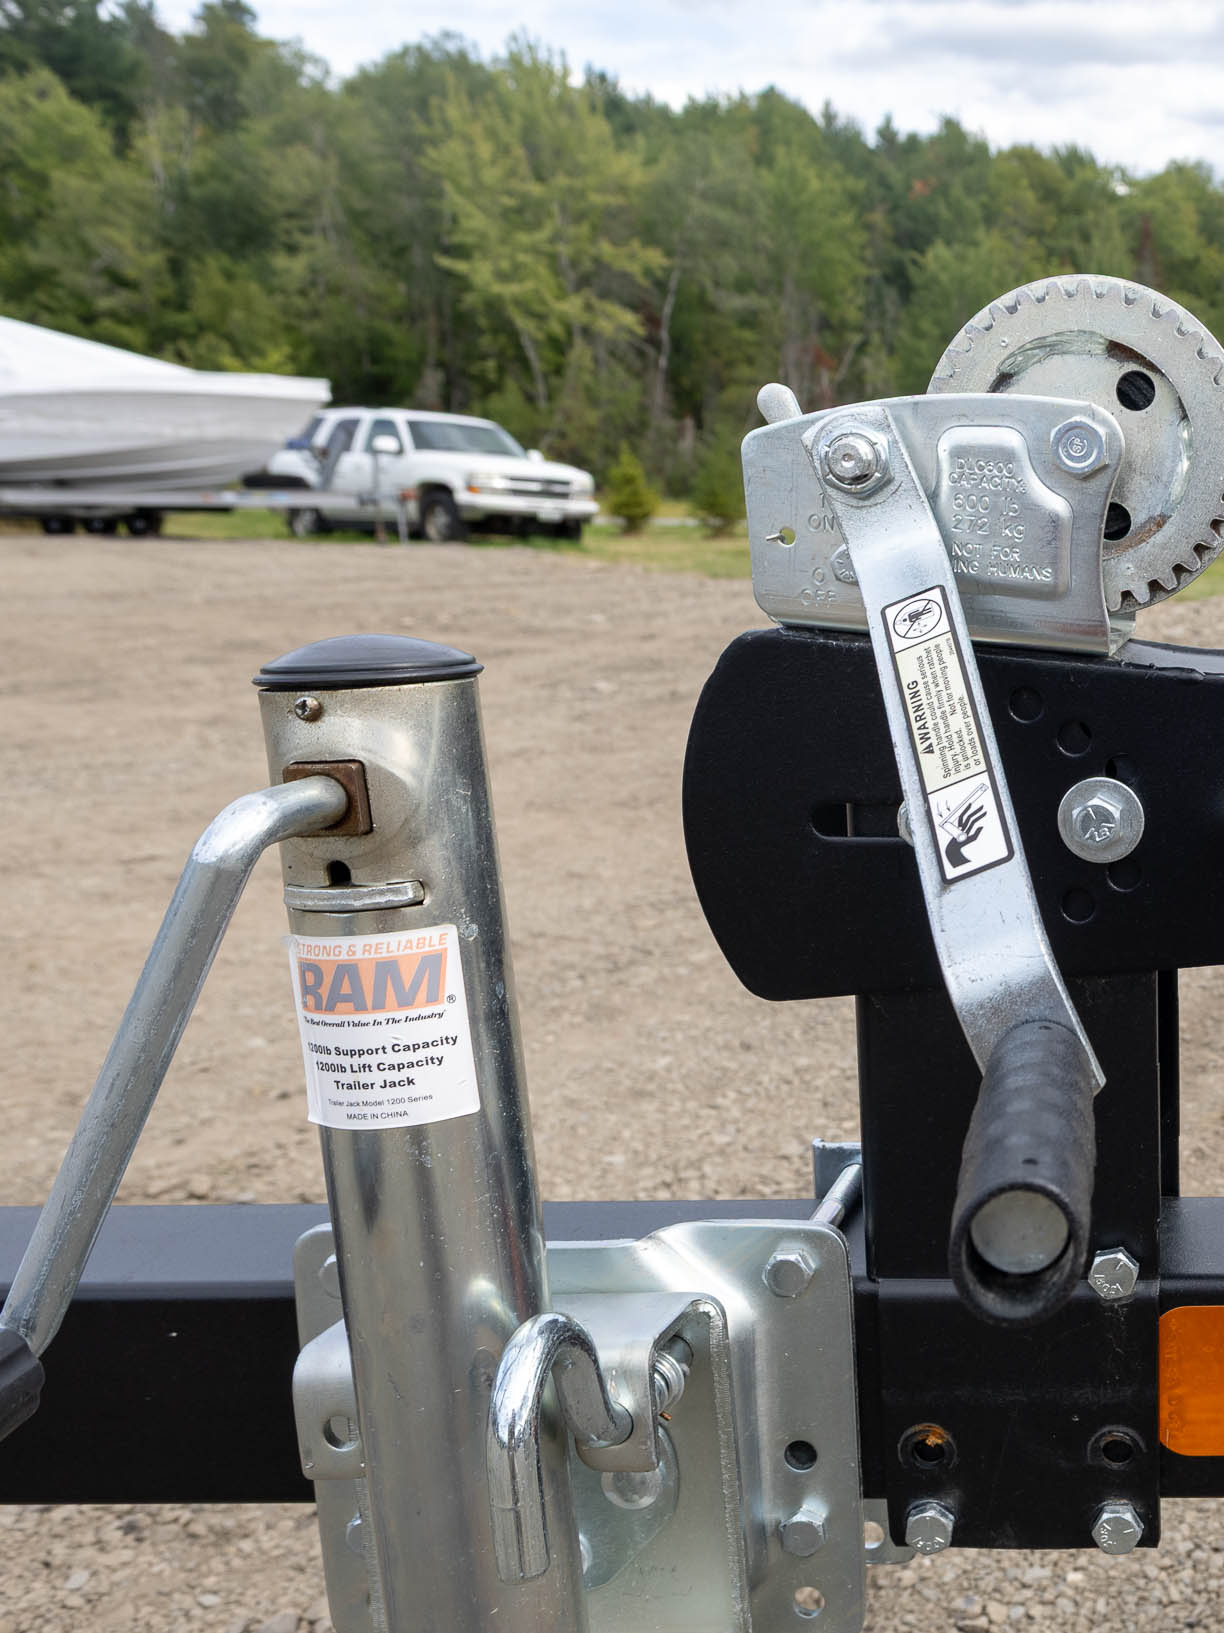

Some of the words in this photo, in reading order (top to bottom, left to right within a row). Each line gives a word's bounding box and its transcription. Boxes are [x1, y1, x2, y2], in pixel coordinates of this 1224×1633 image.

[952, 492, 991, 513] 600
[1001, 496, 1021, 516] lb
[807, 513, 836, 532] ON
[951, 513, 990, 535] 272
[1001, 517, 1025, 542] kg
[951, 541, 982, 558] NOT
[991, 545, 1021, 561] FOR
[987, 562, 1053, 581] HUMANS
[800, 588, 837, 608] OFF
[917, 655, 927, 680] serious
[924, 646, 935, 670] ratchet
[930, 670, 940, 689] when
[940, 666, 952, 691] moving
[923, 680, 933, 701] cause
[934, 689, 945, 710] firmly
[946, 692, 954, 703] for
[907, 680, 931, 744] WARNING
[927, 700, 937, 721] could
[949, 702, 958, 716] Not
[940, 710, 951, 735] handle
[964, 721, 973, 737] over
[932, 722, 943, 746] handle
[945, 734, 955, 752] Hold
[968, 737, 978, 758] loads
[938, 745, 952, 779] Spinning
[297, 943, 342, 957] STRONG
[346, 943, 357, 957] &
[362, 932, 448, 956] RELIABLE
[301, 952, 443, 1012] RAM
[320, 1019, 346, 1028] Overall
[347, 1020, 371, 1028] Value
[372, 1019, 382, 1027] In
[384, 1017, 402, 1026] The
[334, 1045, 388, 1059] Support
[391, 1034, 458, 1053] Capacity
[315, 1060, 347, 1074] 1200lb
[350, 1063, 373, 1074] Lift
[377, 1055, 444, 1073] Capacity
[333, 1080, 376, 1091] Trailer
[380, 1076, 416, 1089] Jack
[328, 1098, 345, 1107] Trailer
[346, 1100, 361, 1108] Jack
[362, 1099, 384, 1108] Model
[387, 1097, 406, 1105] 1200
[407, 1094, 433, 1103] Series
[346, 1112, 368, 1121] MADE
[370, 1112, 379, 1120] IN
[380, 1110, 409, 1119] CHINA
